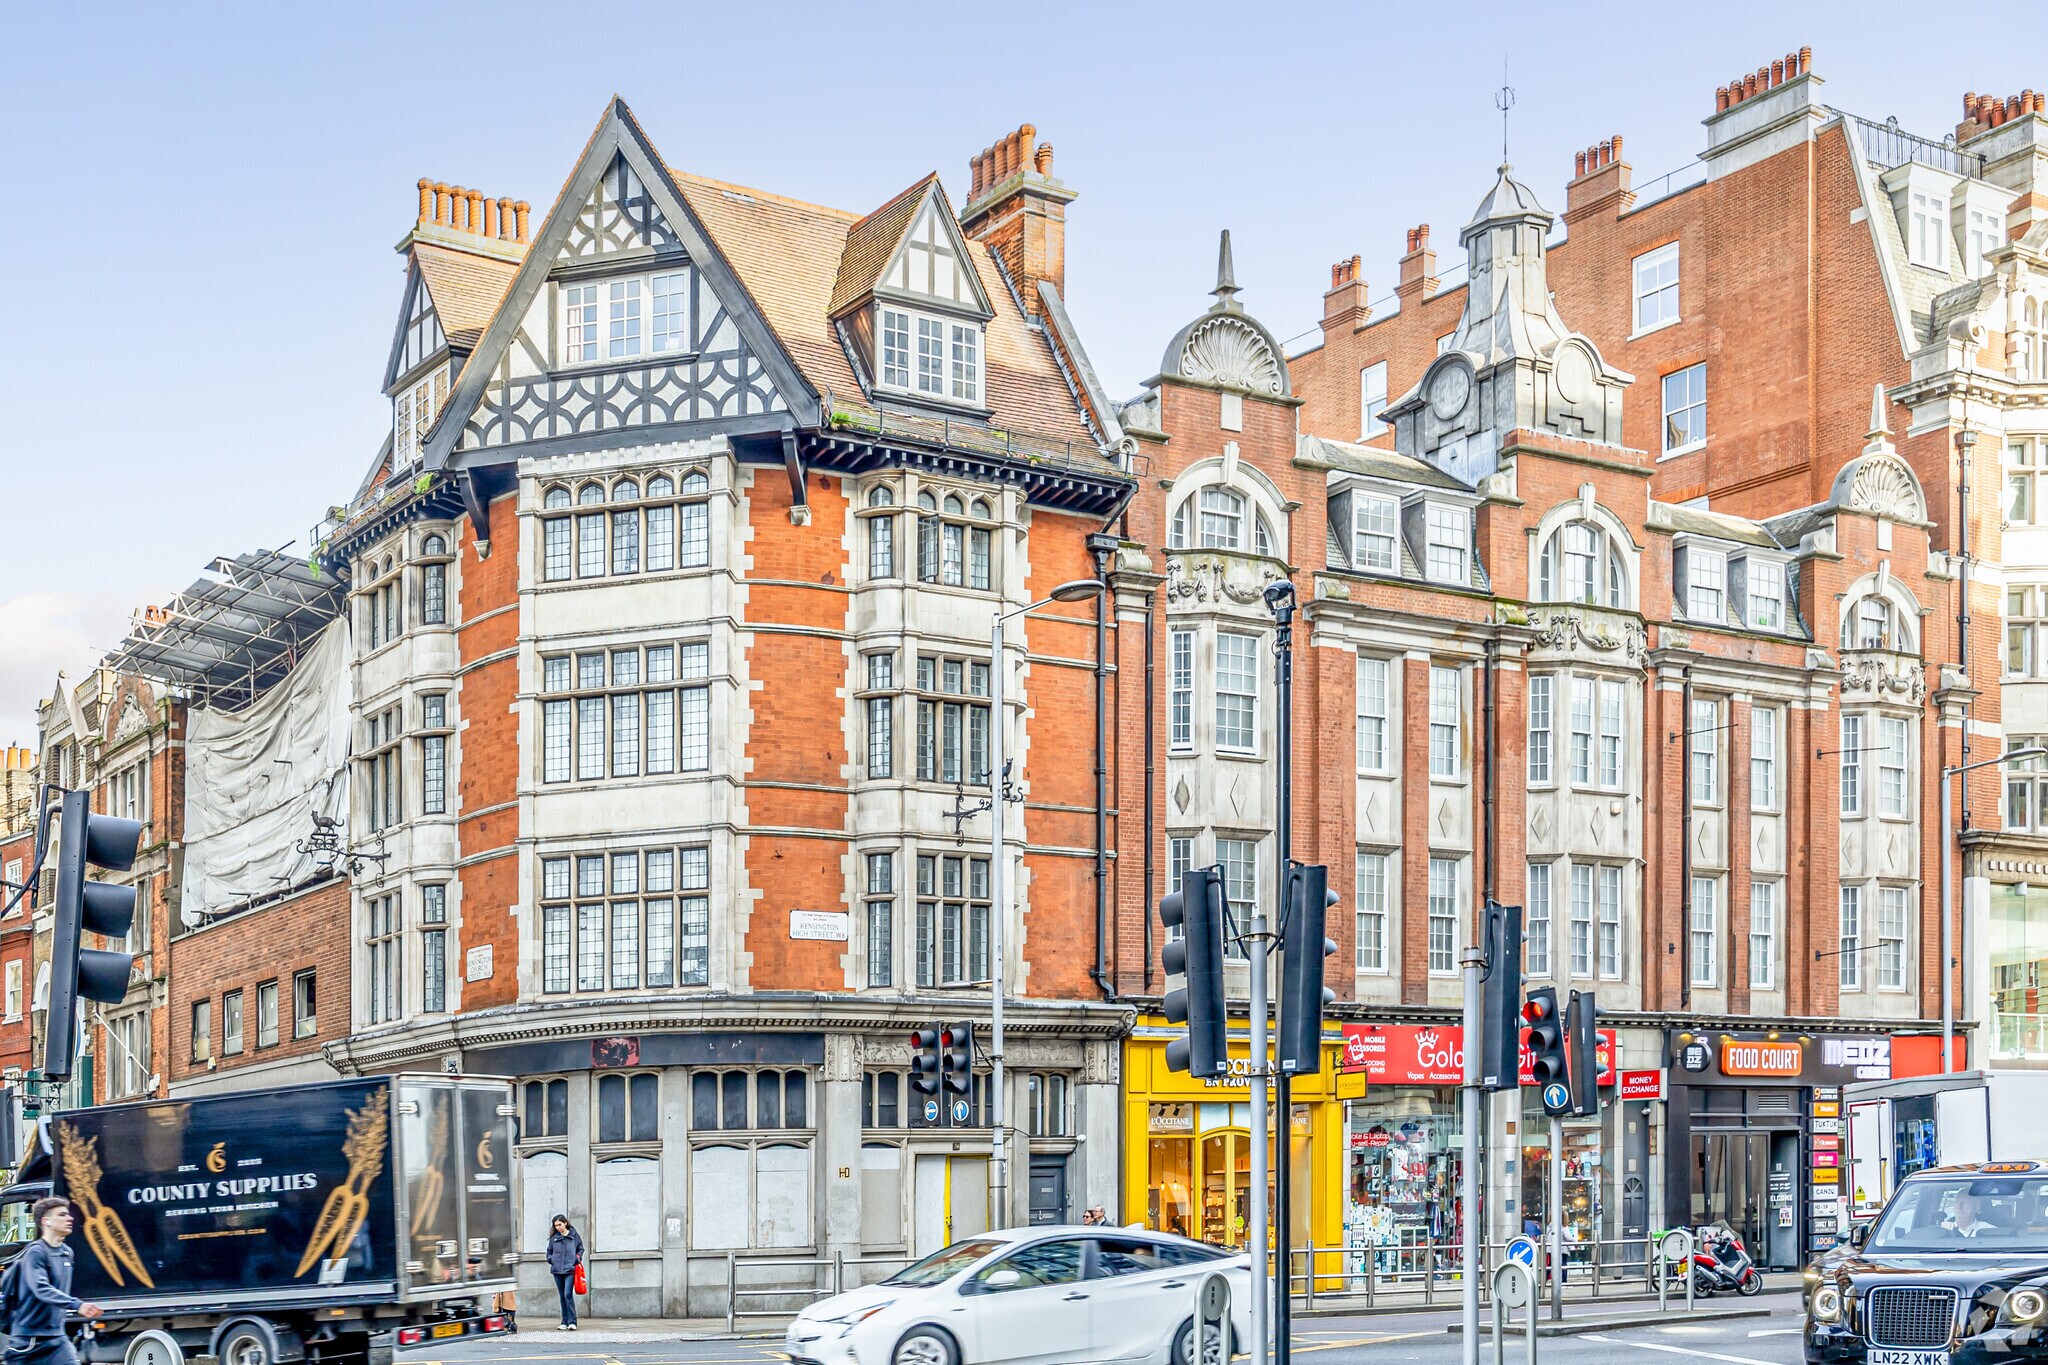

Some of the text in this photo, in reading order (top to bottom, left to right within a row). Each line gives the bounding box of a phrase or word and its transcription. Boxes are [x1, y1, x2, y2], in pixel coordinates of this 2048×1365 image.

[1729, 1048, 1799, 1070] FOOD COURT
[1407, 1072, 1424, 1080] Vapes
[1205, 1077, 1219, 1087] EN
[1623, 1085, 1659, 1093] EXCHANGE
[1151, 1117, 1190, 1125] L'OCCITANE
[1369, 1132, 1390, 1141] Laptop
[128, 1173, 318, 1204] COUNTY SUPPLIES
[1816, 1237, 1836, 1245] ADORA
[1873, 1351, 1943, 1365] LN22 XWK
